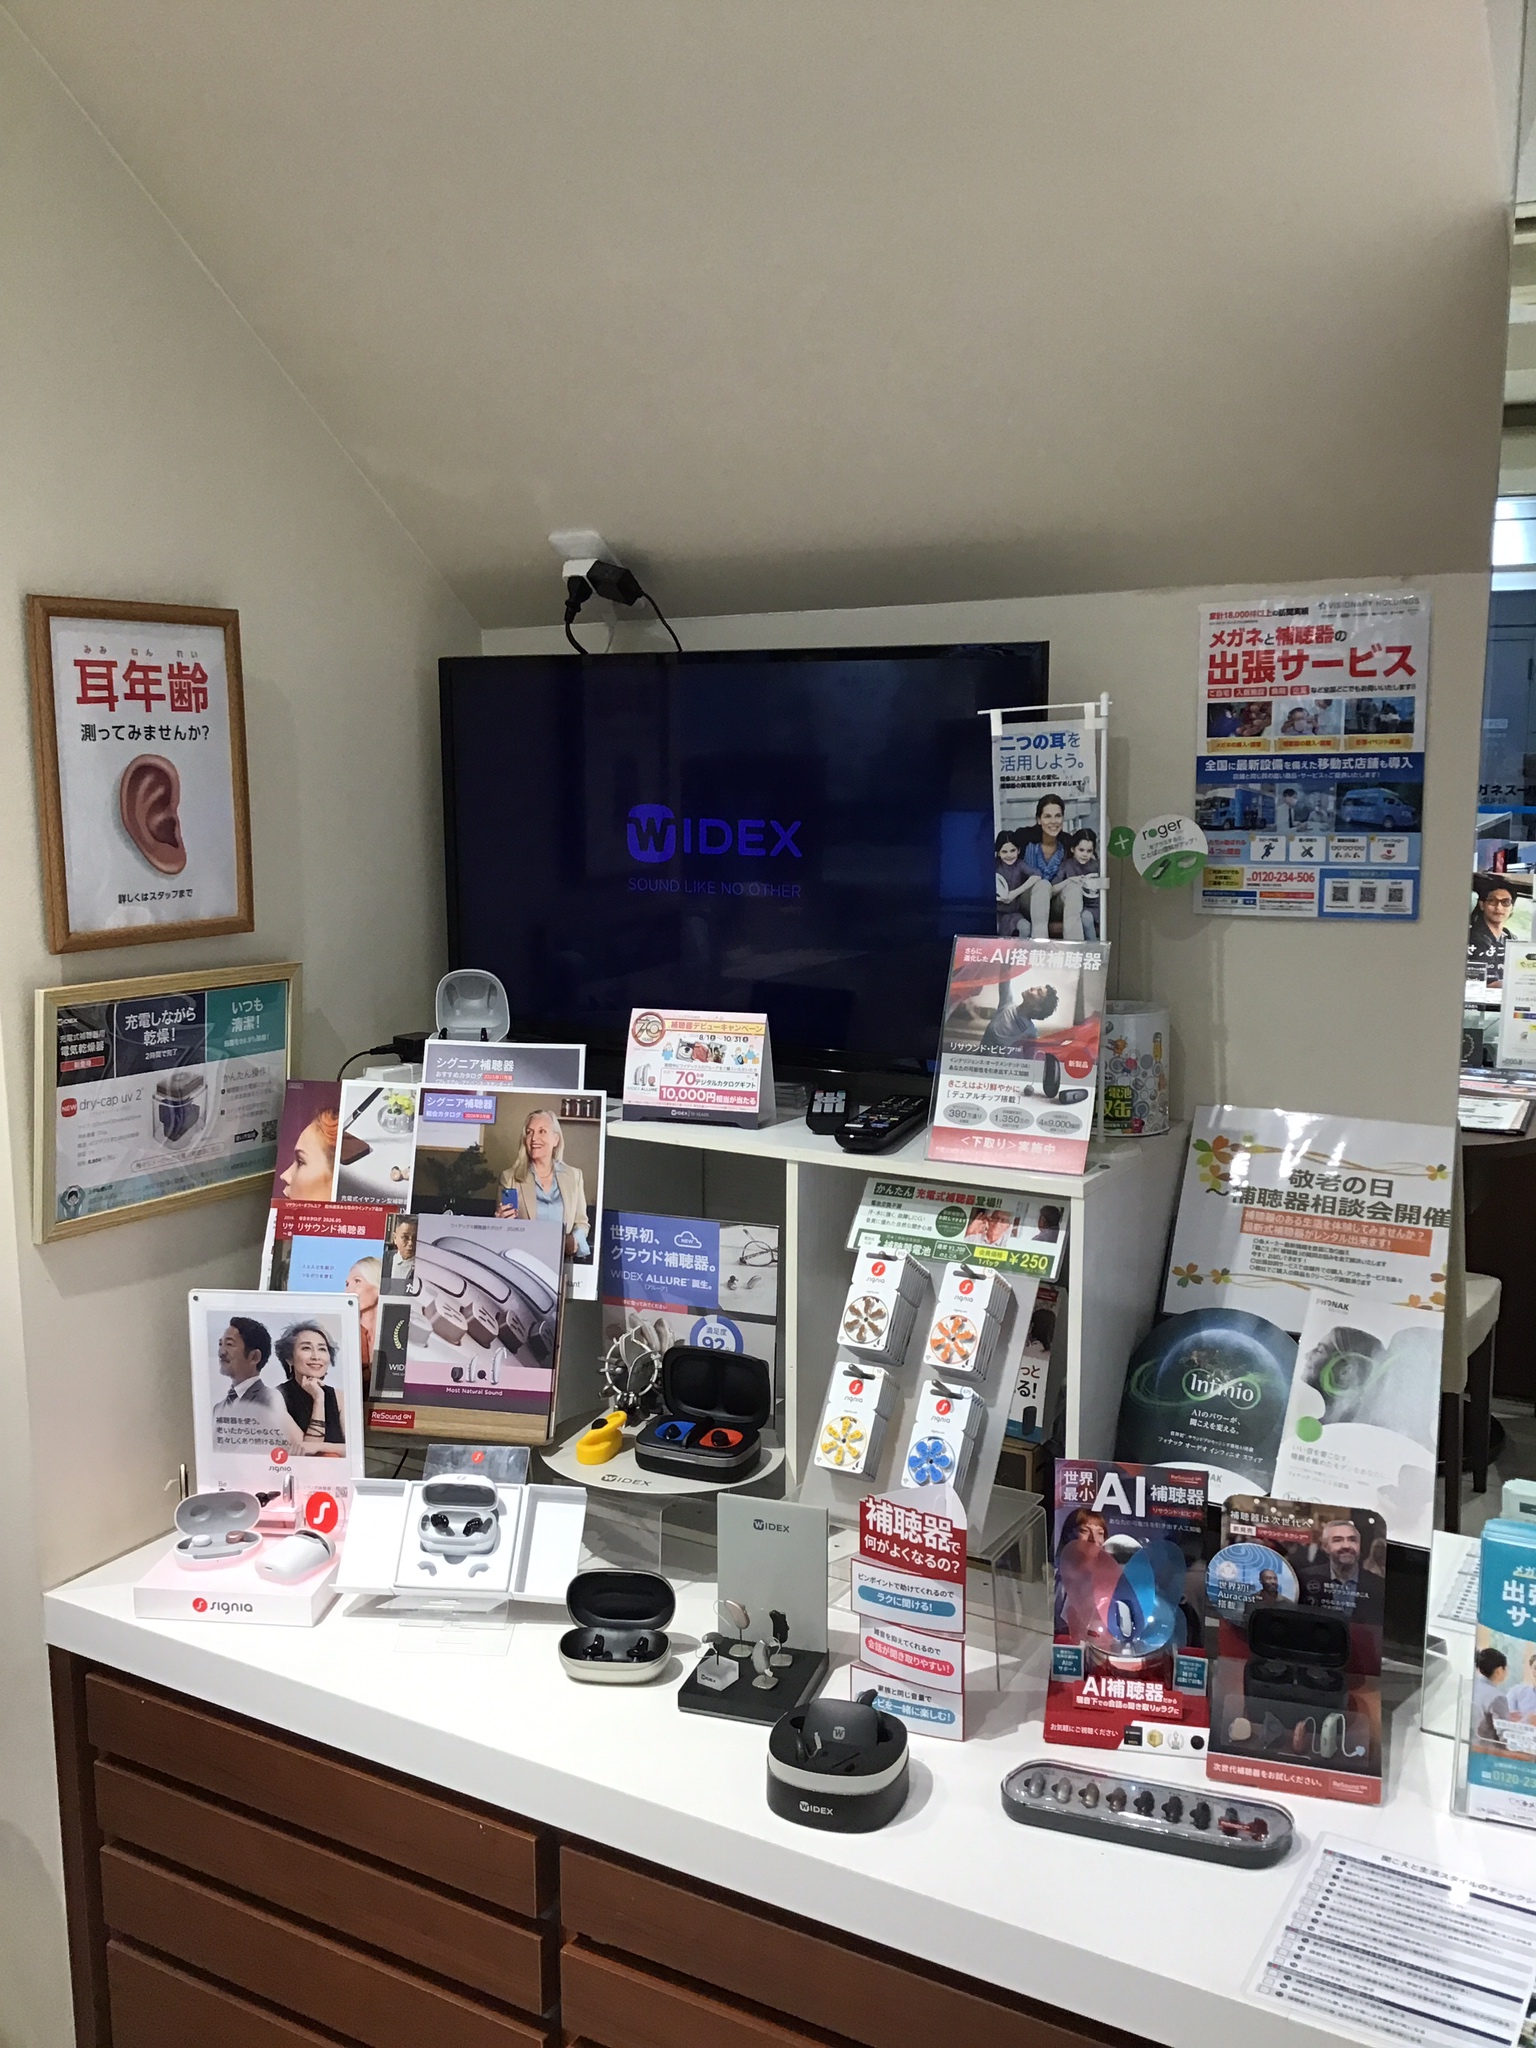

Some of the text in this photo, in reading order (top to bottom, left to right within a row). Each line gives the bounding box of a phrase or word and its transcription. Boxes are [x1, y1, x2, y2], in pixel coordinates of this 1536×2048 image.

[1208, 624, 1348, 648] メガネと補聴器の
[1207, 643, 1418, 686] 出張サービス
[73, 658, 210, 714] 耳年齢
[80, 723, 210, 743] 測ってみませんか?
[1000, 732, 1081, 751] 二つの耳を
[1000, 753, 1084, 772] 活用しよう。
[627, 803, 802, 863] WIDEX
[1251, 871, 1316, 883] 0120-234-506
[628, 877, 802, 899] SOUND LIKE NO OTHER
[990, 948, 1102, 970] AI搭載補聴器
[232, 998, 264, 1015] いつも
[125, 1006, 198, 1031] 充電しながら
[143, 1026, 177, 1047] 乾燥!
[436, 1057, 515, 1072] シグニア補聴器
[676, 1071, 697, 1086] 70
[61, 1103, 78, 1113] NEW
[79, 1095, 119, 1112] dry-cap
[121, 1093, 135, 1103] uv
[426, 1096, 493, 1110] シグニア補聴器
[874, 1184, 914, 1198] かんたん
[1289, 1169, 1395, 1199] 敬老の日
[297, 1222, 366, 1236] リサウンド補聴器
[610, 1225, 661, 1245] 世界初、
[610, 1246, 716, 1273] クラウド補聴器。
[1009, 1252, 1049, 1271] ¥250
[610, 1269, 643, 1282] WIDEX
[865, 1276, 886, 1285] signia
[953, 1295, 974, 1304] signia
[446, 1387, 503, 1397] Most Natural Sound
[1190, 1372, 1255, 1402] Infinio
[844, 1395, 864, 1404] signia
[371, 1411, 402, 1421] ReSound
[930, 1415, 951, 1424] signia
[268, 1464, 292, 1473] signia
[600, 1473, 653, 1487] WIDEX
[1063, 1471, 1095, 1486] 世界
[1063, 1487, 1095, 1502] 最小
[1091, 1472, 1147, 1518] AI
[1150, 1484, 1206, 1507] 補聴器
[752, 1518, 791, 1533] WIDEX
[1229, 1510, 1313, 1528] 補聴器は次世代へ
[864, 1533, 961, 1575] 何がよくなるの?
[209, 1601, 254, 1614] signia
[876, 1591, 934, 1613] ラクに聞ける!
[873, 1627, 942, 1656] 雑音を抑えてくれるので
[868, 1638, 951, 1674] 会話が聞き取りやすい!
[877, 1683, 933, 1703] 家族と同じ音量で
[1213, 1762, 1324, 1788] 次世代補聴器をお試しください。
[799, 1800, 834, 1816] WIDEX
